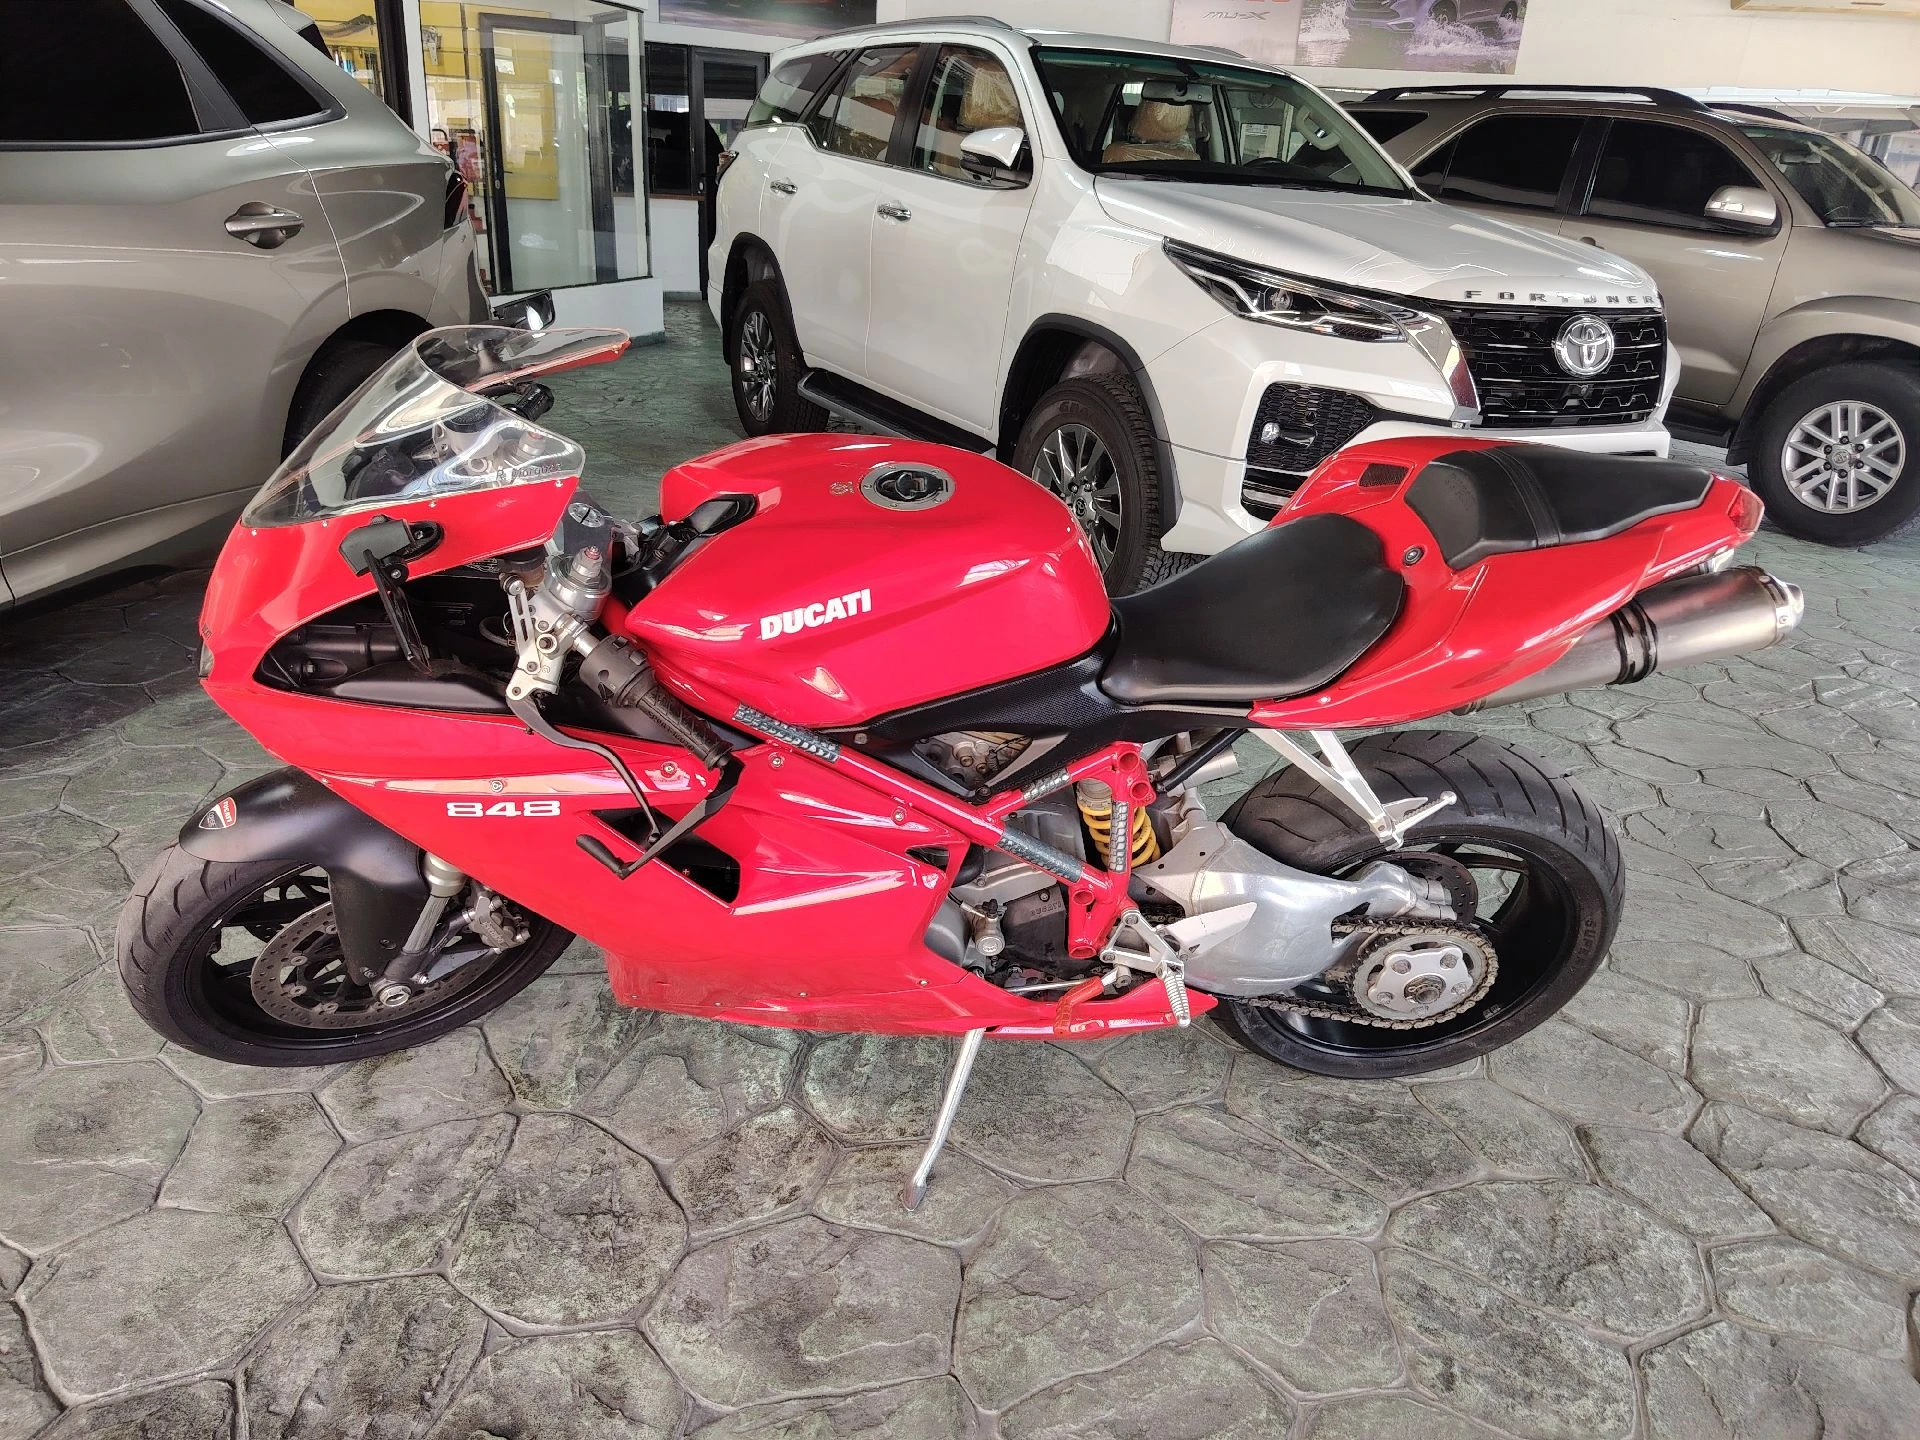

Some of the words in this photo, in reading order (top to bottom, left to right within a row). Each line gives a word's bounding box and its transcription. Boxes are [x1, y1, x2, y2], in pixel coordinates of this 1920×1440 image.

[1464, 289, 1656, 305] FORTUNER
[760, 588, 872, 641] DUCATI
[446, 800, 561, 818] 848
